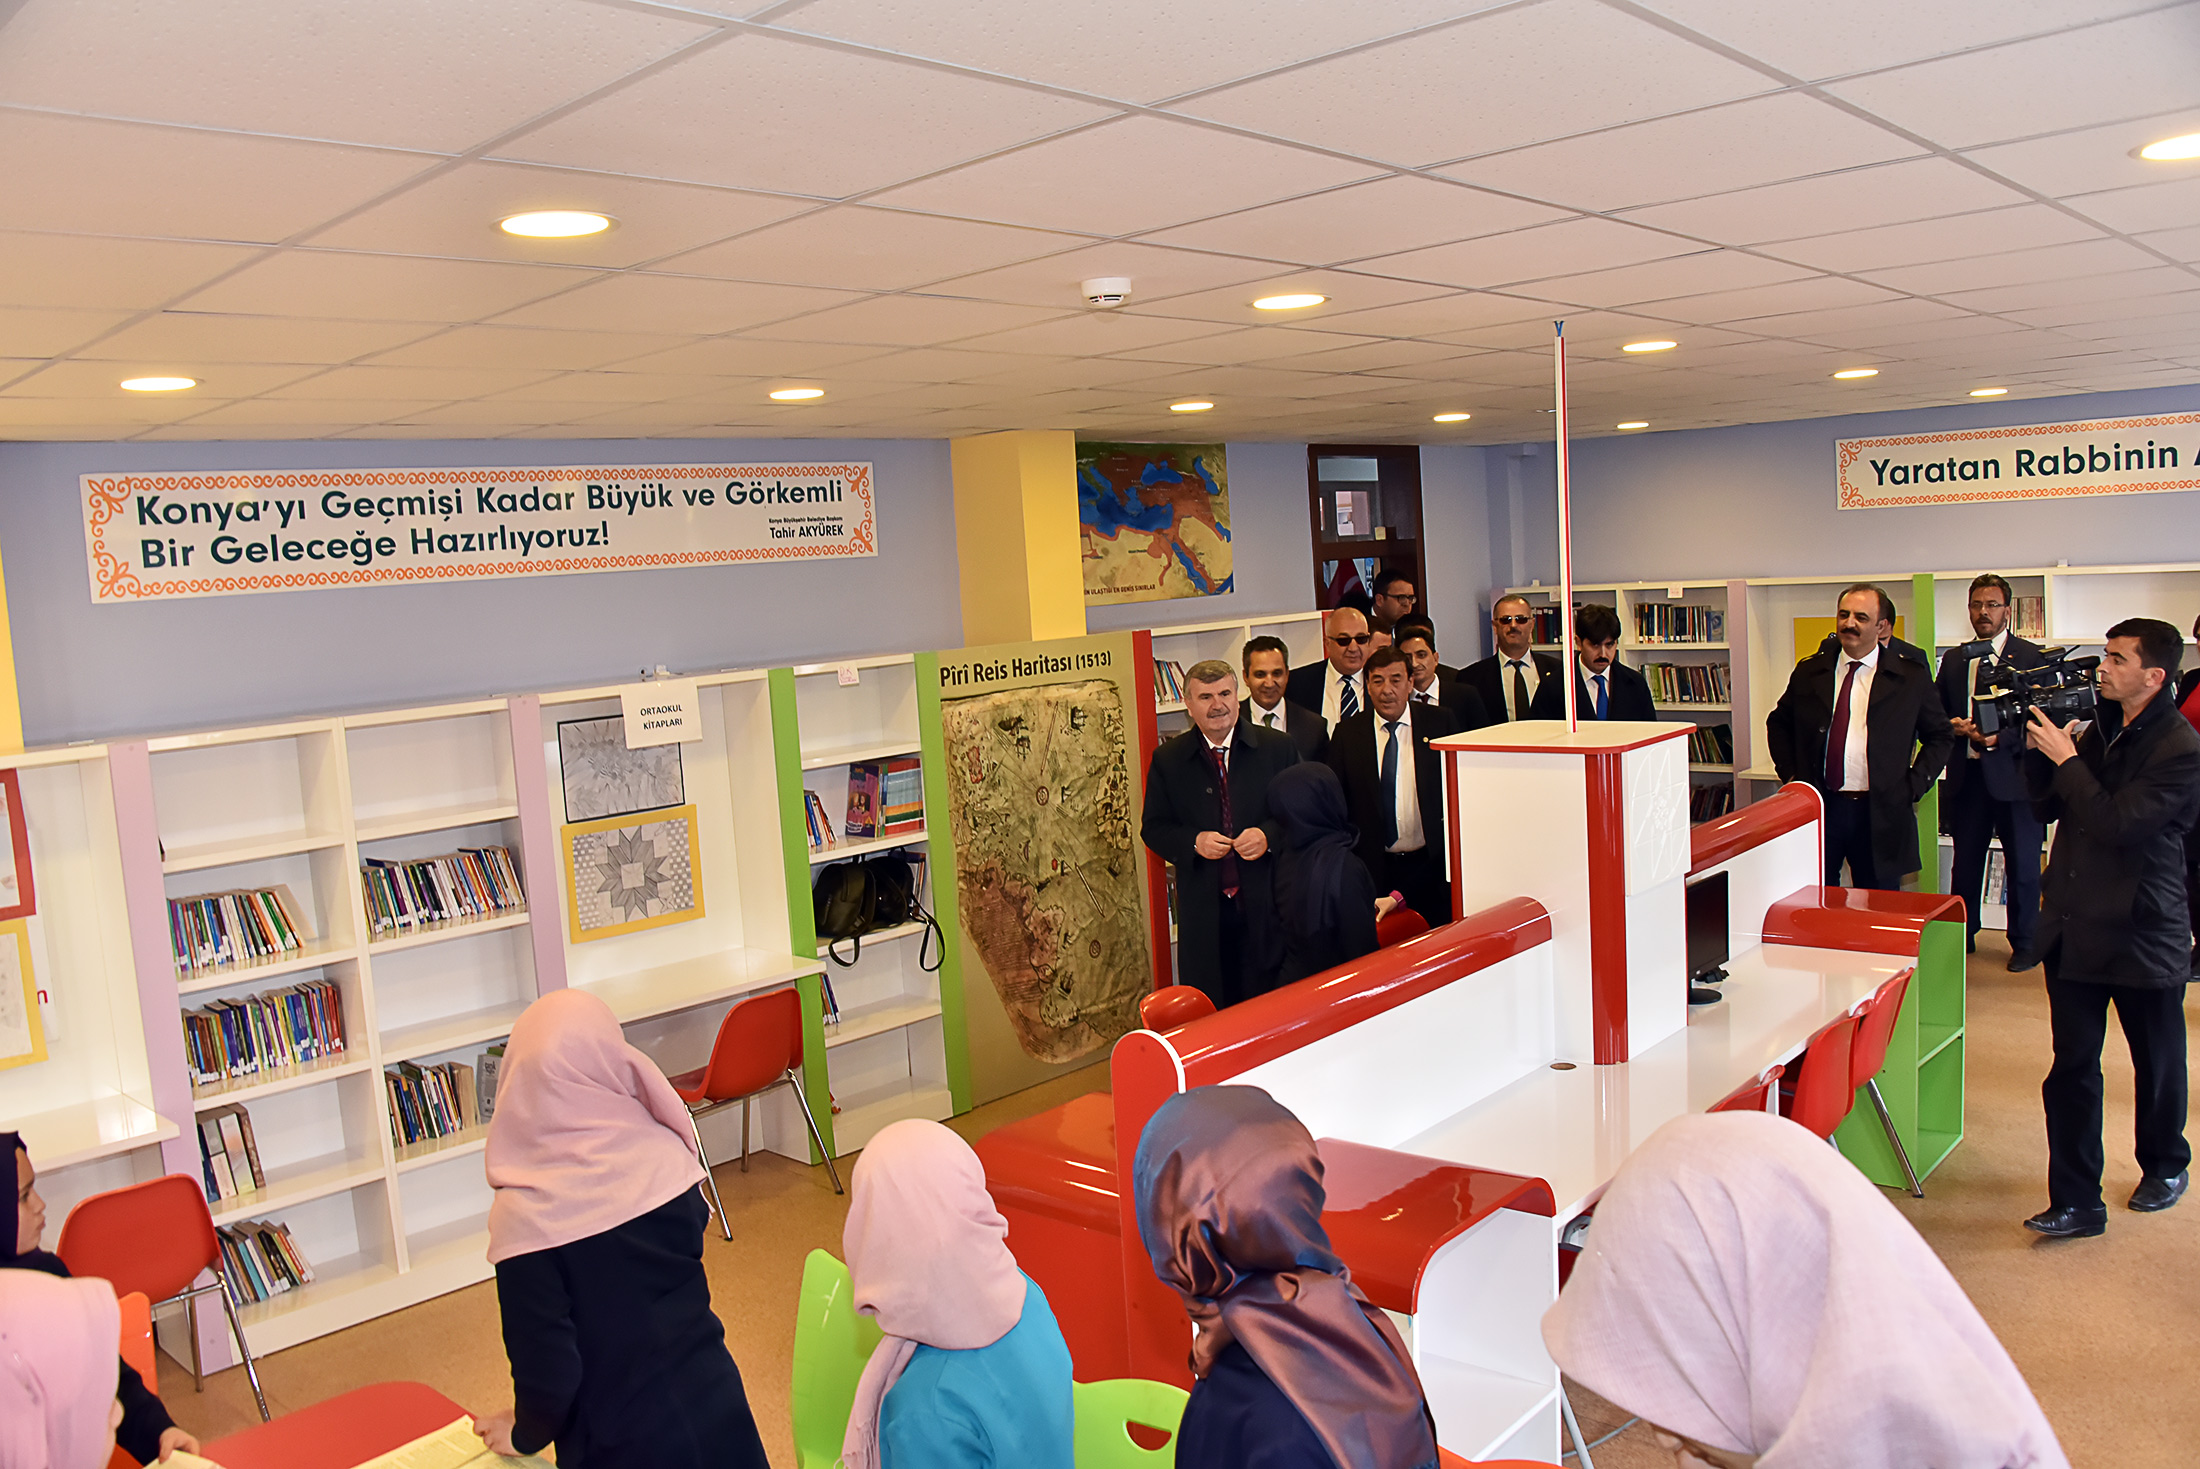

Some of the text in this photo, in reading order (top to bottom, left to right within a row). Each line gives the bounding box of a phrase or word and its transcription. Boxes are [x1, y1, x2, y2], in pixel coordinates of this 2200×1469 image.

[1869, 457, 2000, 486] Yaratan
[2015, 440, 2178, 477] Rabbinin
[136, 480, 844, 532] Konya'yı Geçmişi Kadar Büyük ve Görkemli
[140, 521, 609, 569] Bir Geleceğe Hazırlıyoruz!
[769, 523, 844, 539] Tahir AKYÜREK
[973, 660, 1008, 683] Reis
[1012, 654, 1072, 678] Haritası
[1076, 651, 1111, 671] (1513)
[640, 704, 683, 716] ORTAOKUL
[643, 718, 683, 730] KİTAPLARI
